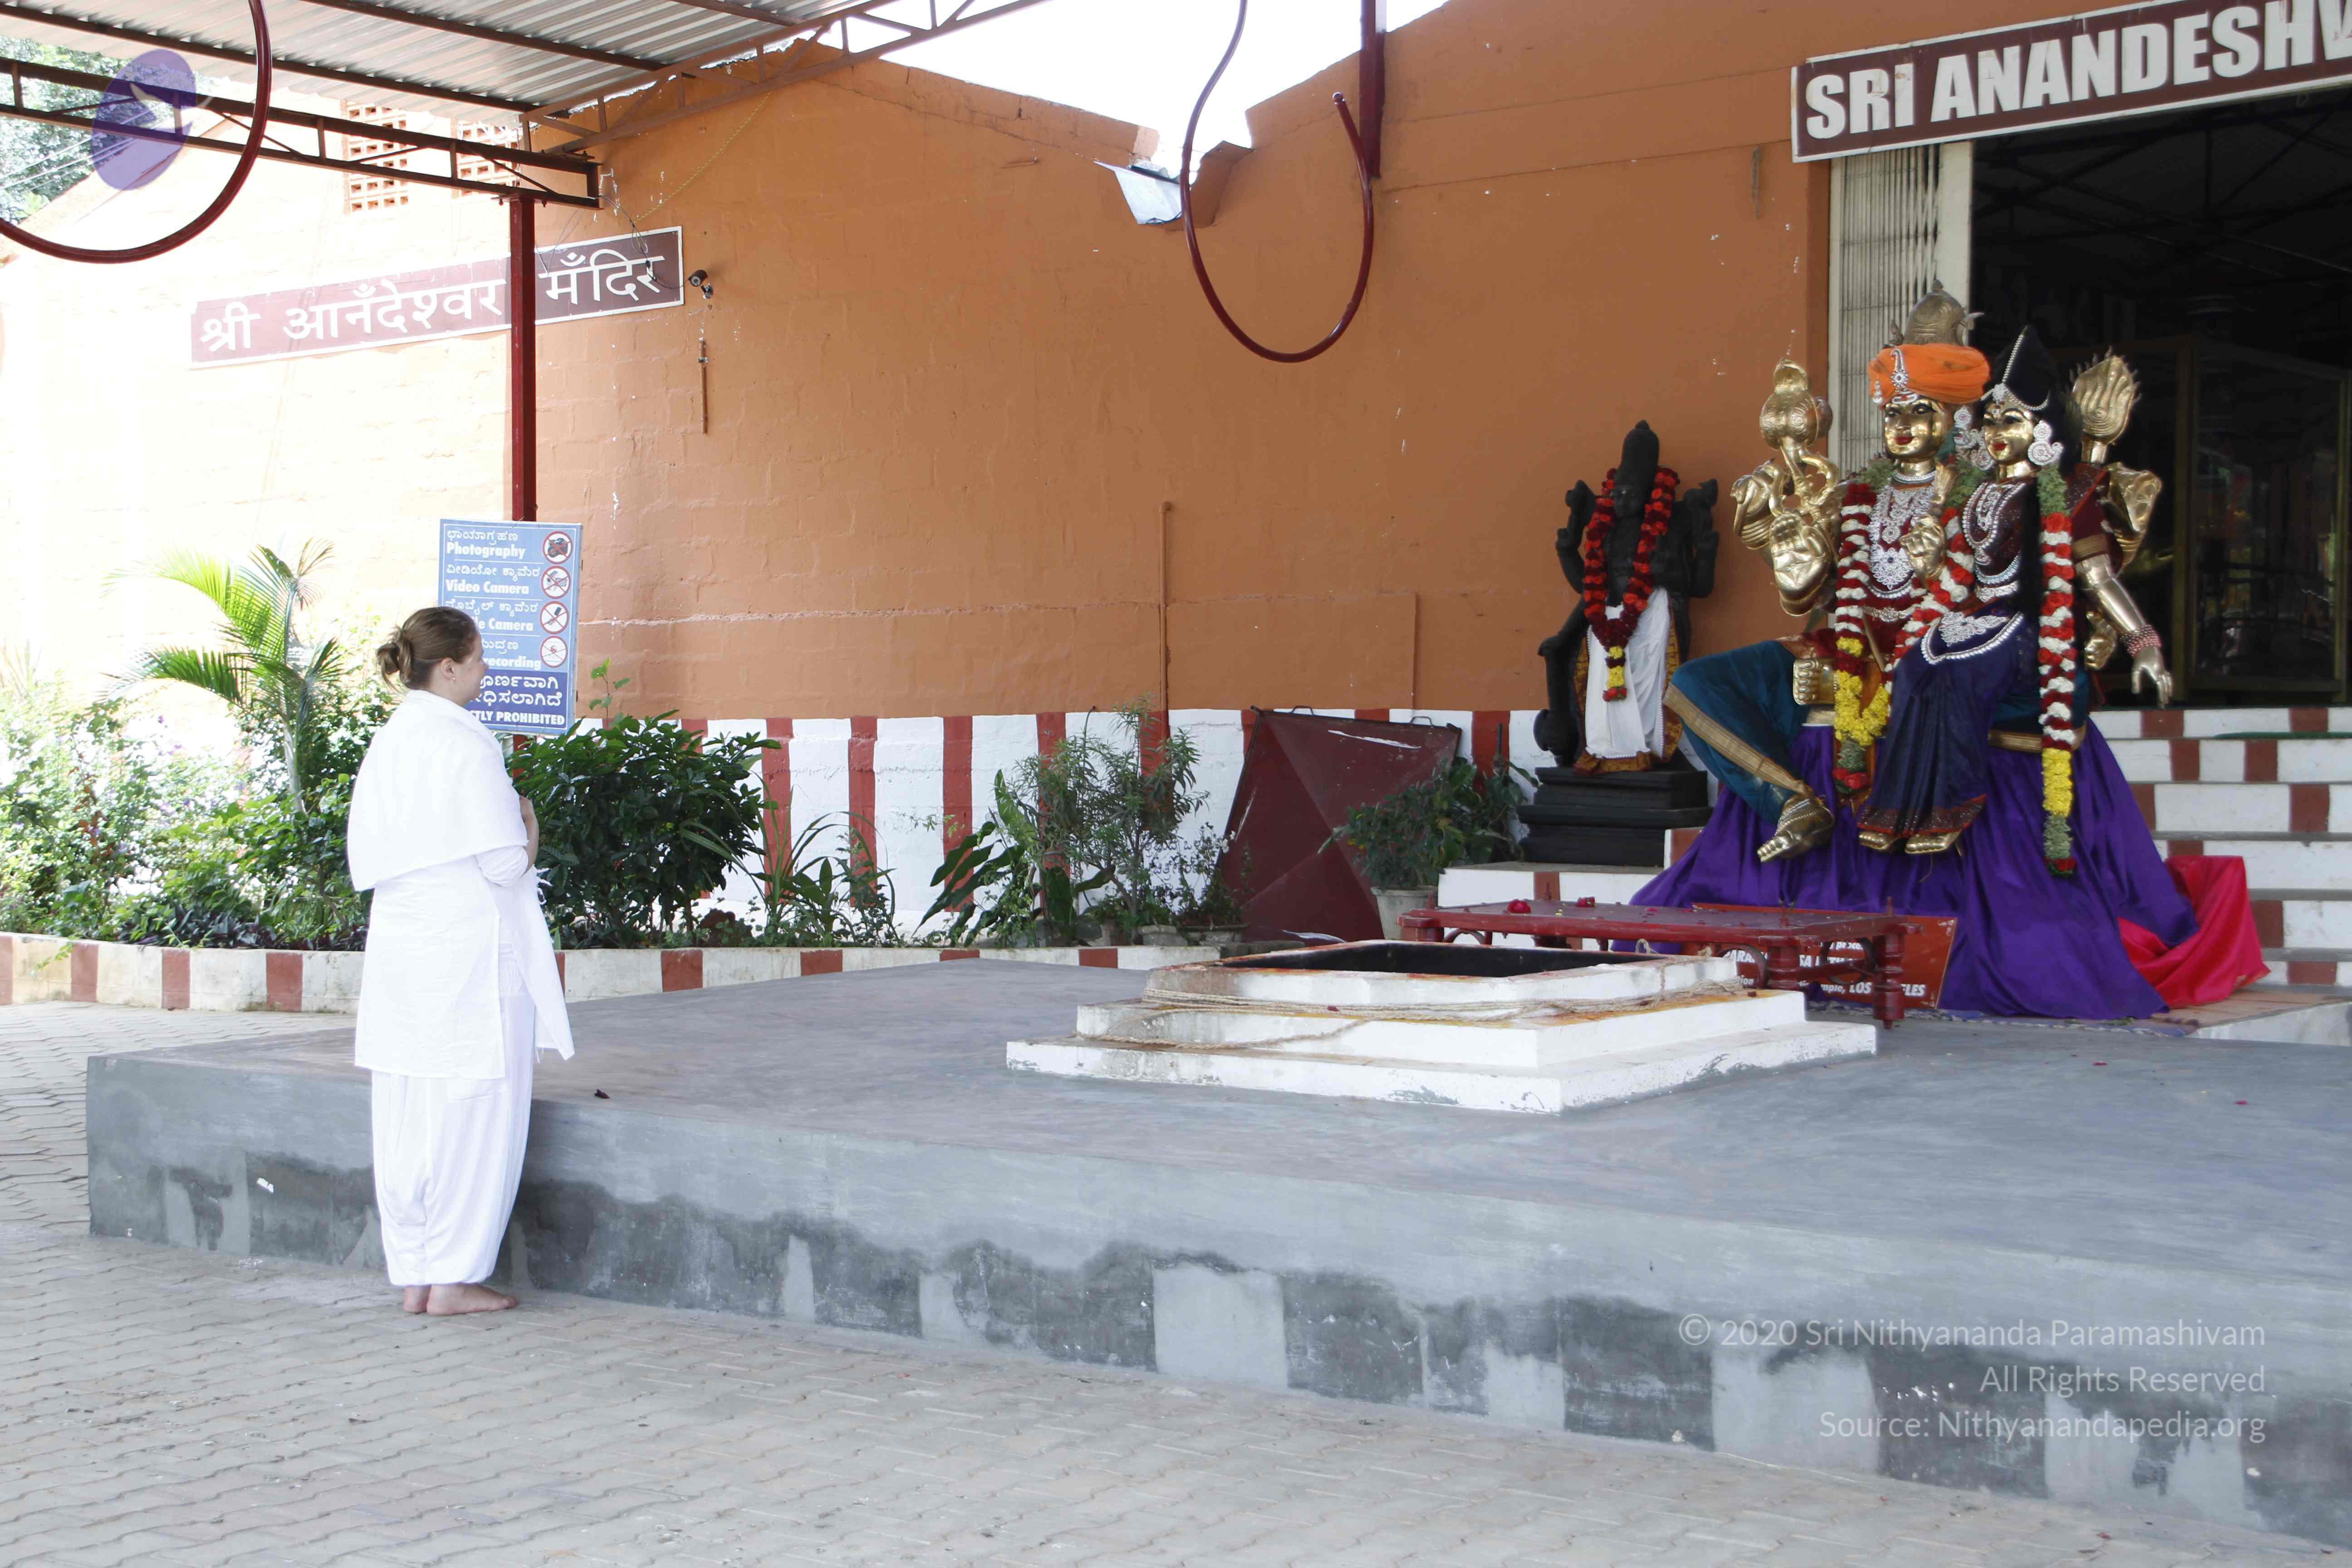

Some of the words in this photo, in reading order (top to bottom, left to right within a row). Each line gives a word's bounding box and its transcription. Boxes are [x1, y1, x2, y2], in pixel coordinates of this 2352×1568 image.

[1805, 63, 1913, 139] SRI
[200, 301, 261, 352] श्री
[446, 542, 526, 559] Photography
[446, 579, 480, 593] Video
[483, 581, 529, 594] Camera
[489, 617, 534, 631] Camera
[496, 711, 565, 725] PROHIBITED
